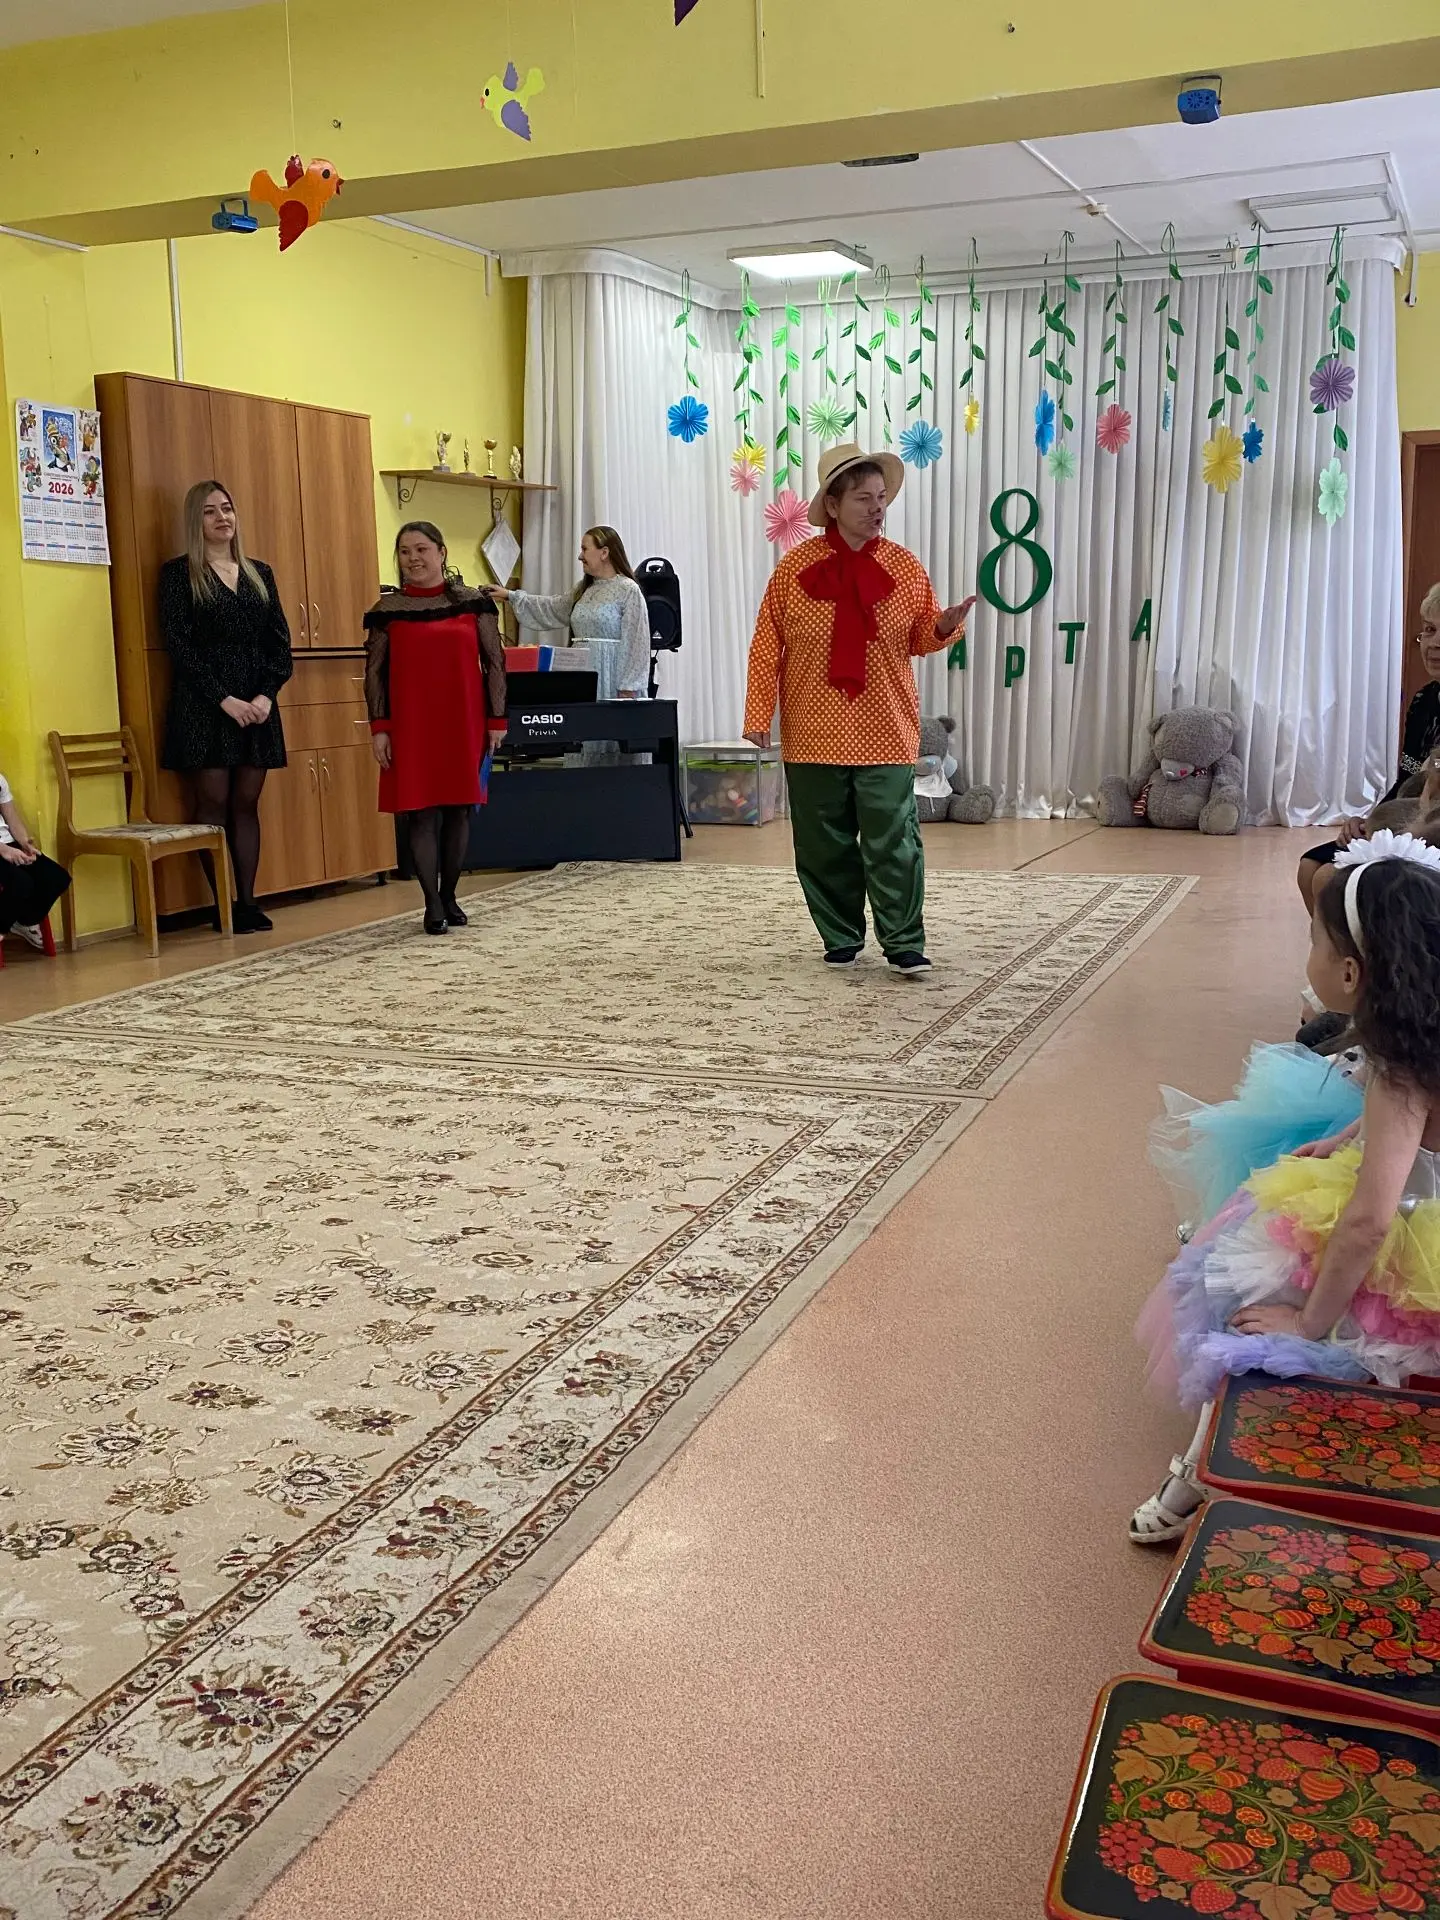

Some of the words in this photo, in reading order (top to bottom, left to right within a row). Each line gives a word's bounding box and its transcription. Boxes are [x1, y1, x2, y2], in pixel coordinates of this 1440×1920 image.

[48, 481, 74, 495] 2026
[979, 488, 1053, 615] 8
[948, 598, 1152, 688] АРТА
[521, 714, 564, 725] CASIO
